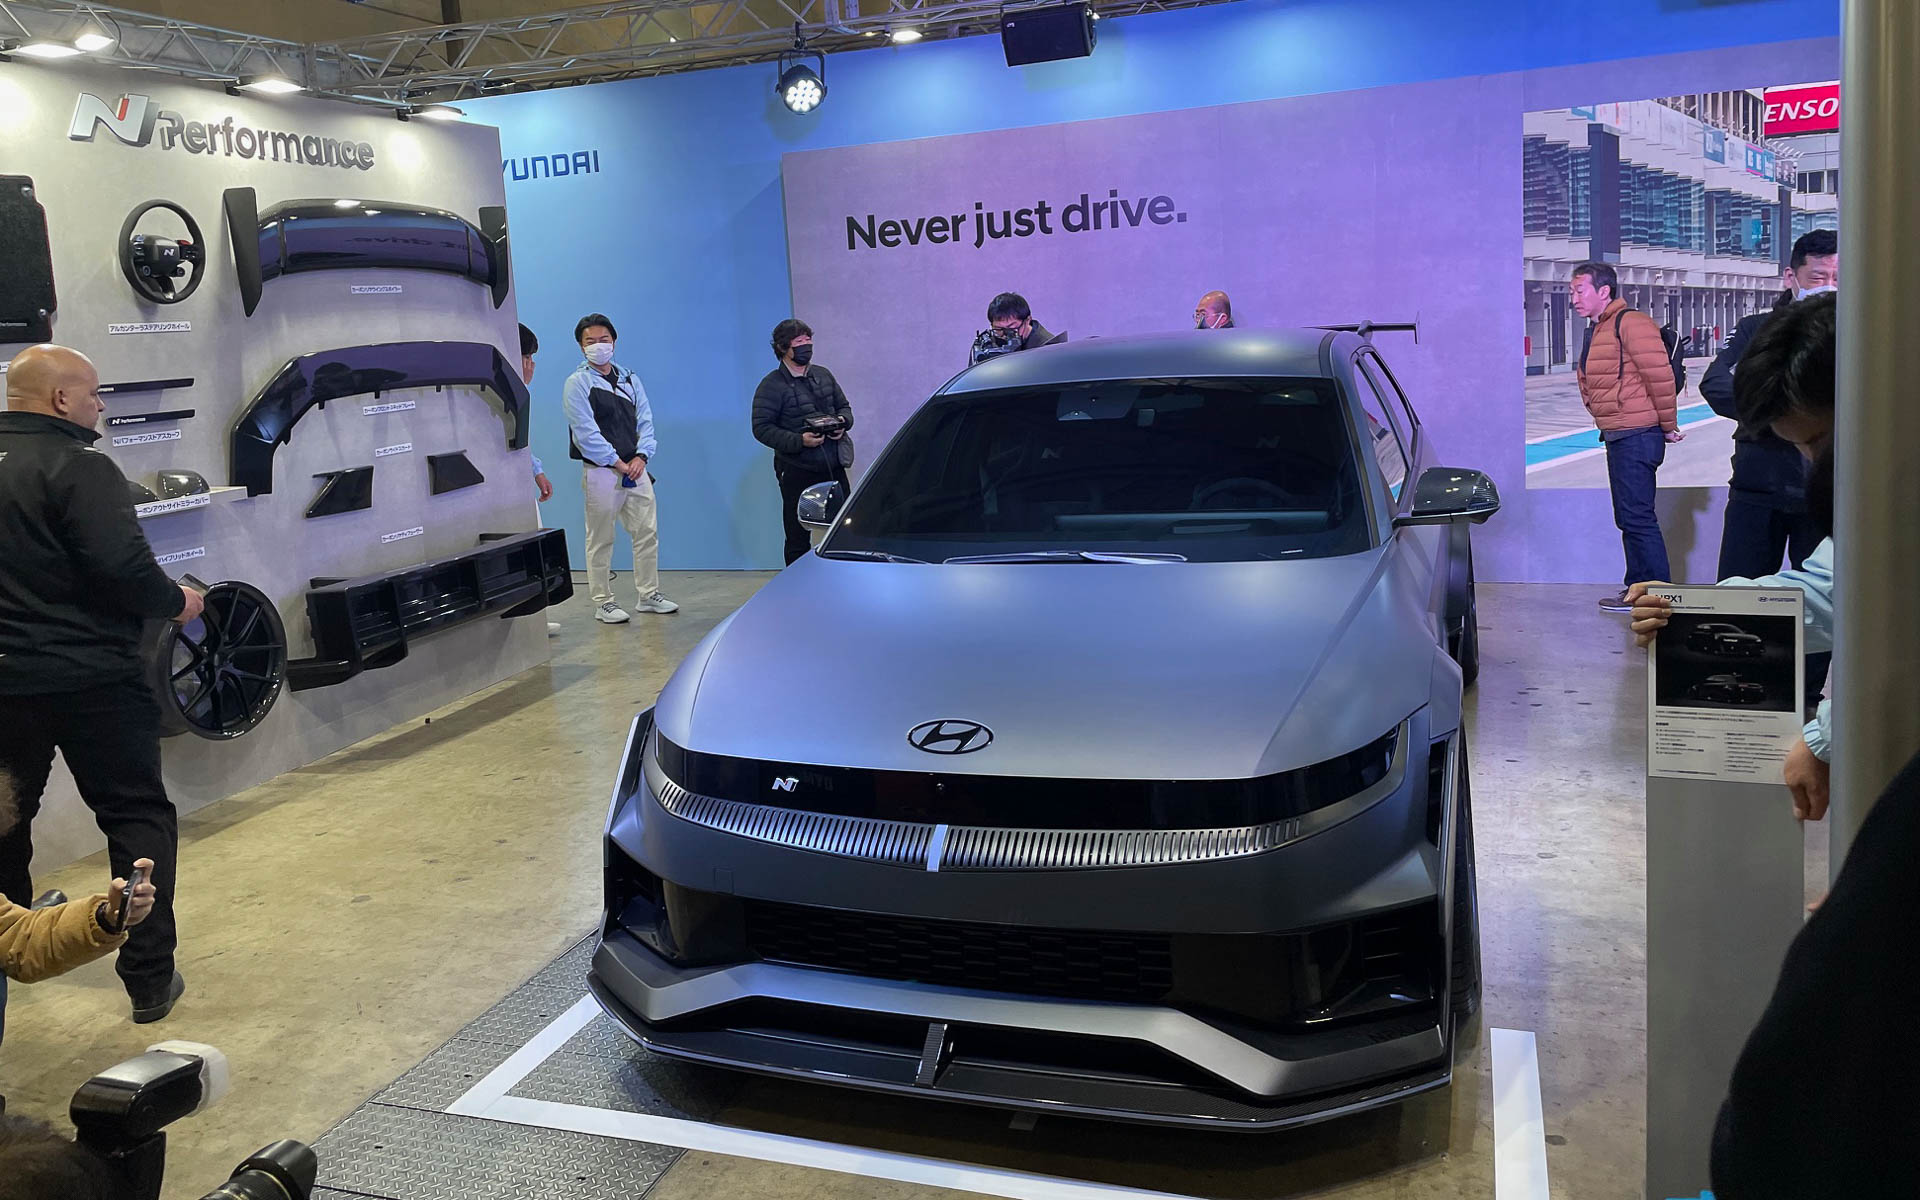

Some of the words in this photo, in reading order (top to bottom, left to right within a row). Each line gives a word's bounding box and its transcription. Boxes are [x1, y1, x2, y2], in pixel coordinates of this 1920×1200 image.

[1763, 97, 1839, 123] ENSO
[158, 110, 375, 170] Performance
[846, 214, 966, 250] Never
[973, 201, 1053, 248] just
[1061, 189, 1187, 233] drive.
[1656, 594, 1683, 603] PX1
